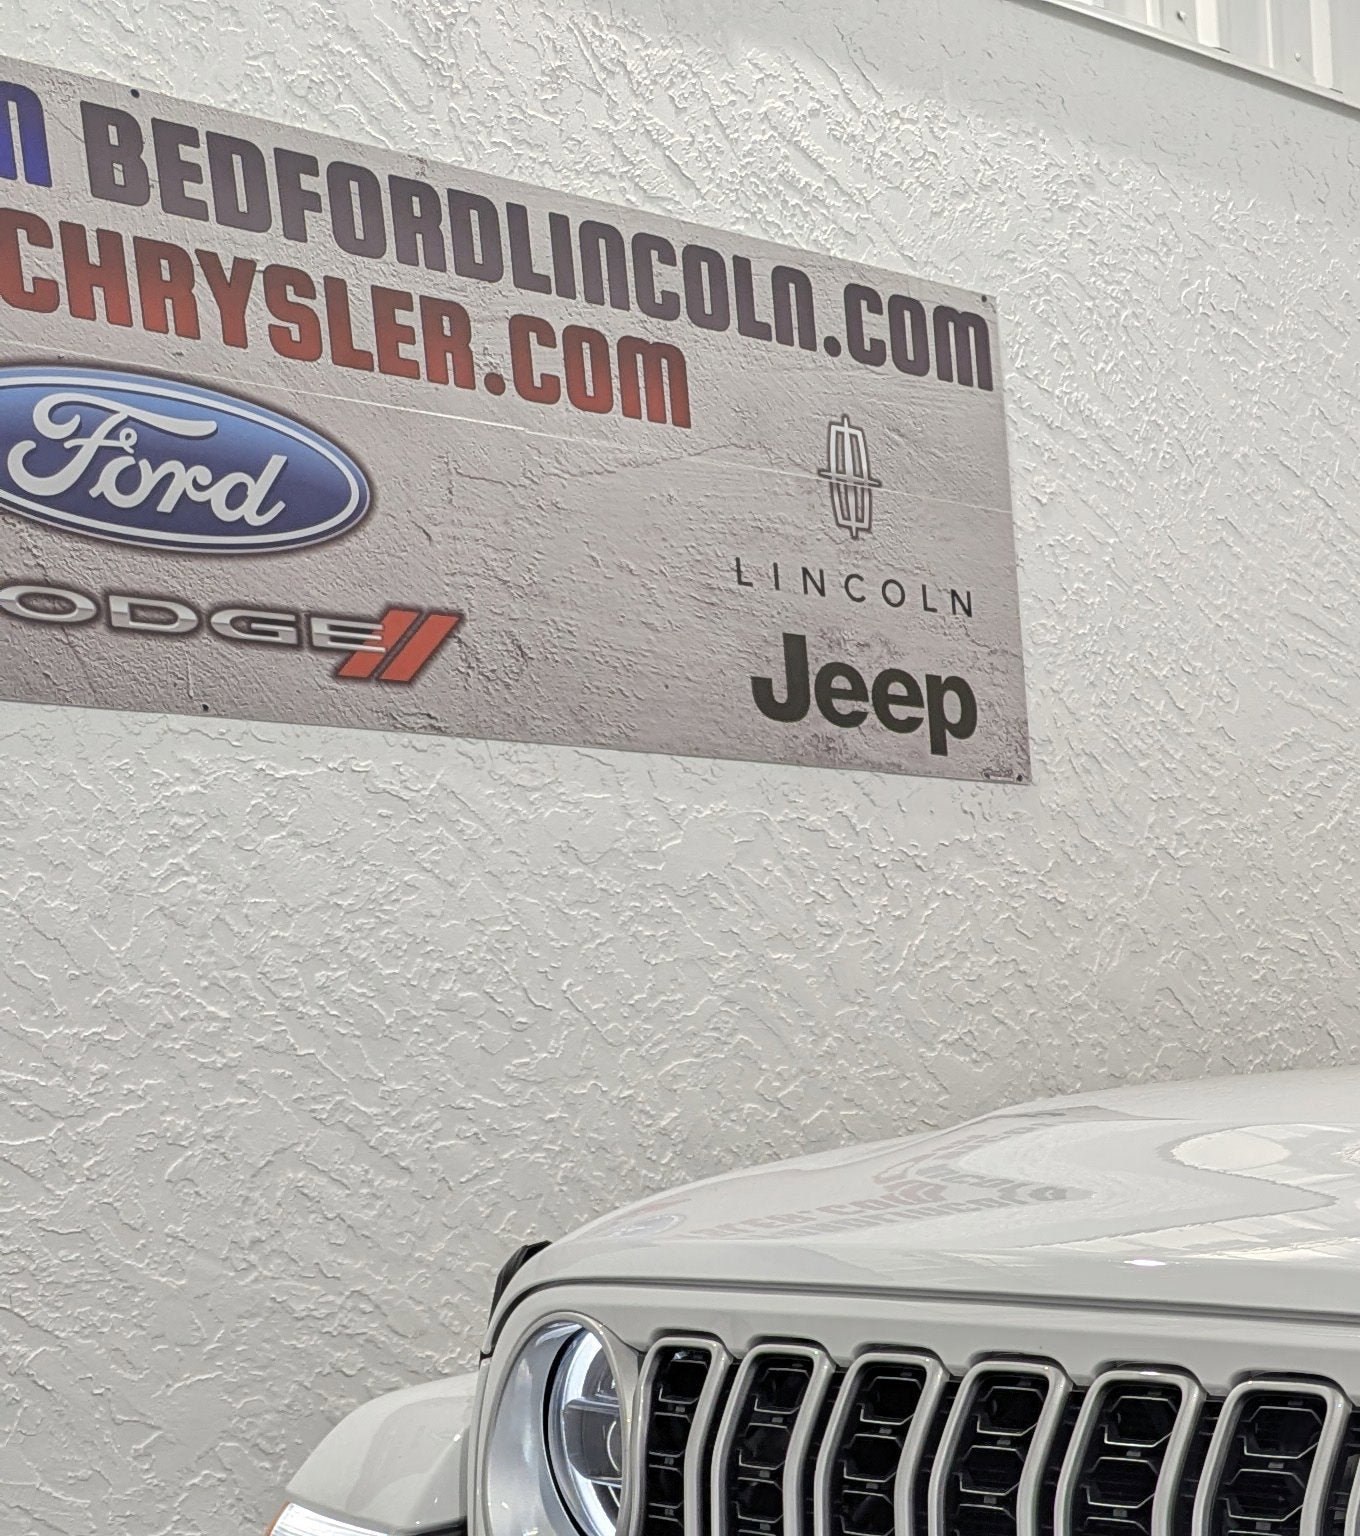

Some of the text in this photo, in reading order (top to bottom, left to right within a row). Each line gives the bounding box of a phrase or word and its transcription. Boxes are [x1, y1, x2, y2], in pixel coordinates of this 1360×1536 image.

[80, 100, 993, 391] BEDFORDLINCOLN.COM
[7, 393, 288, 526] Ford
[0, 584, 387, 653] ODGE
[735, 557, 973, 618] LINCOLN
[751, 632, 978, 757] Jeep
